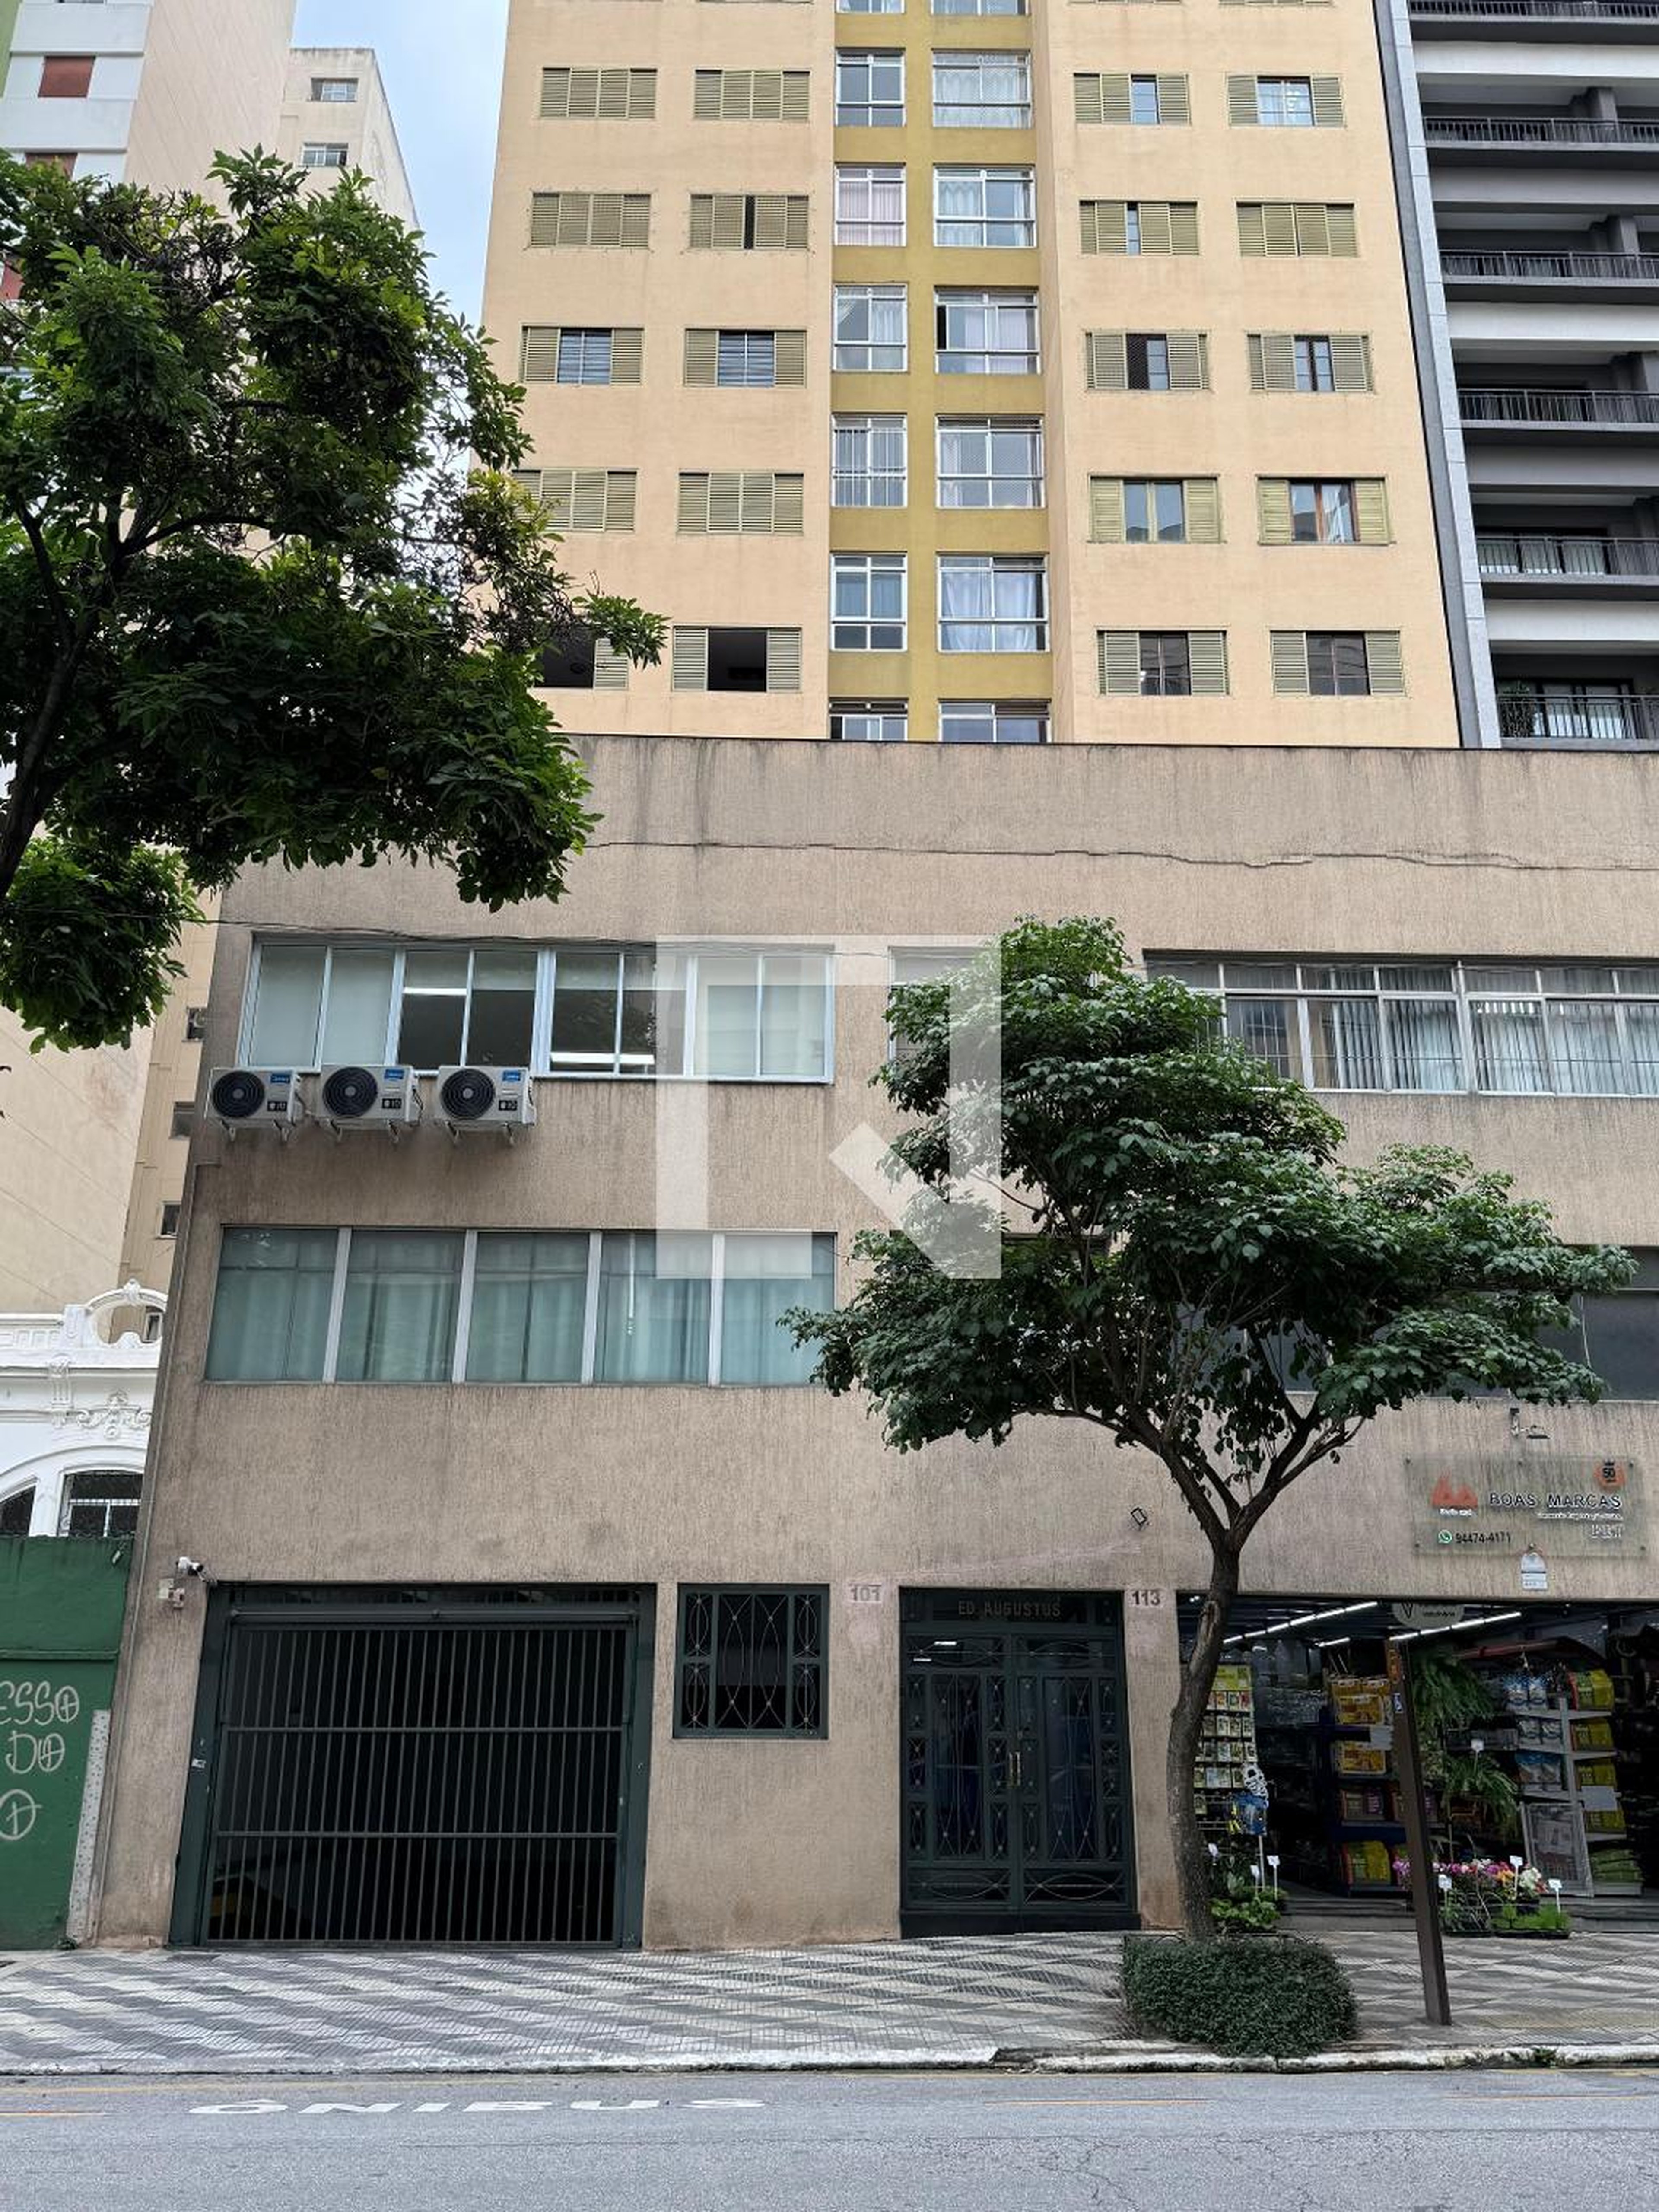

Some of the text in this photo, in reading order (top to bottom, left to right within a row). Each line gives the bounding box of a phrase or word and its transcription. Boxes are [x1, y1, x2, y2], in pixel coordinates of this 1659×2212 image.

[1490, 1492, 1622, 1509] BOAS MARCAS
[1132, 1590, 1160, 1606] 113
[985, 1601, 1061, 1617] AUGUSTUS
[189, 2099, 766, 2114] ÔNIBUS
